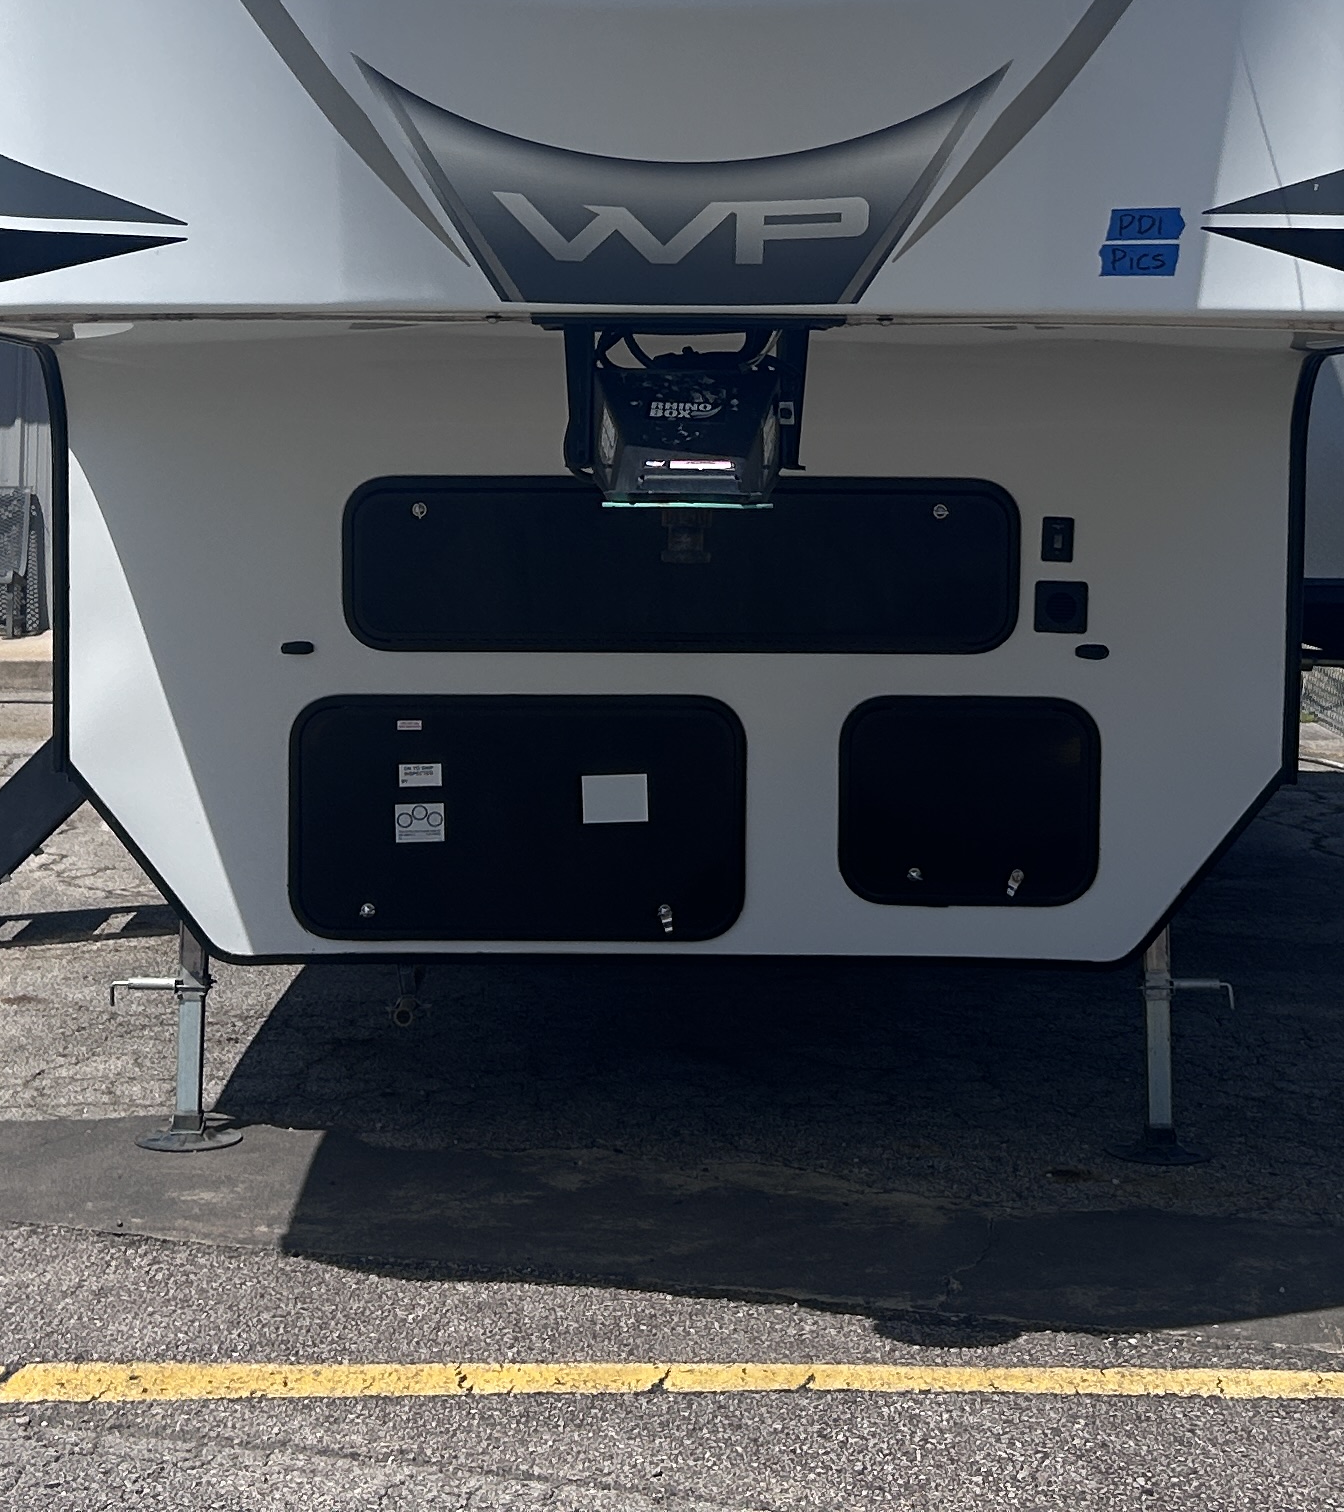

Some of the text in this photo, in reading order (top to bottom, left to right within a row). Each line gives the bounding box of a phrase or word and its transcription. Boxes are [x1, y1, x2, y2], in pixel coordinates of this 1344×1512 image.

[492, 191, 870, 265] WP
[1118, 213, 1163, 237] PDI
[649, 409, 692, 419] BOX
[650, 401, 712, 411] RHINO
